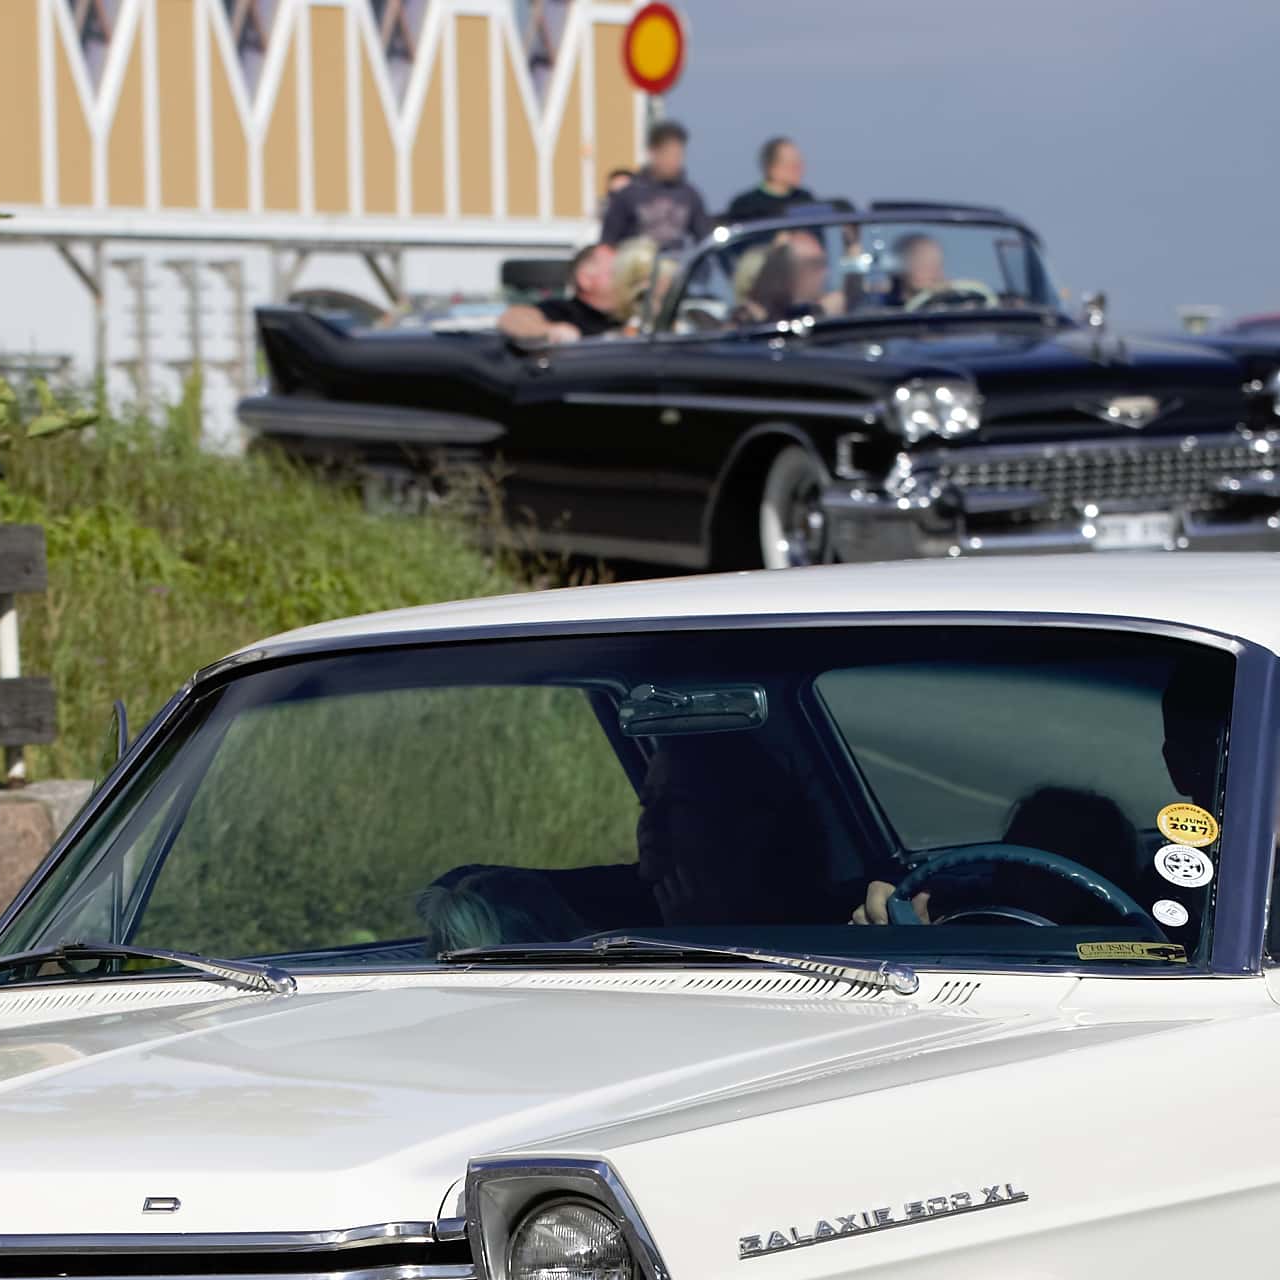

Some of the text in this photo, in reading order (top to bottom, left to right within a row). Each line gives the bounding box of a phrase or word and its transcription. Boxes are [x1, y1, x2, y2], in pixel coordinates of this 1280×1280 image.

[1169, 823, 1208, 835] 2017
[738, 1183, 1026, 1252] GALAXIE 500 XL
